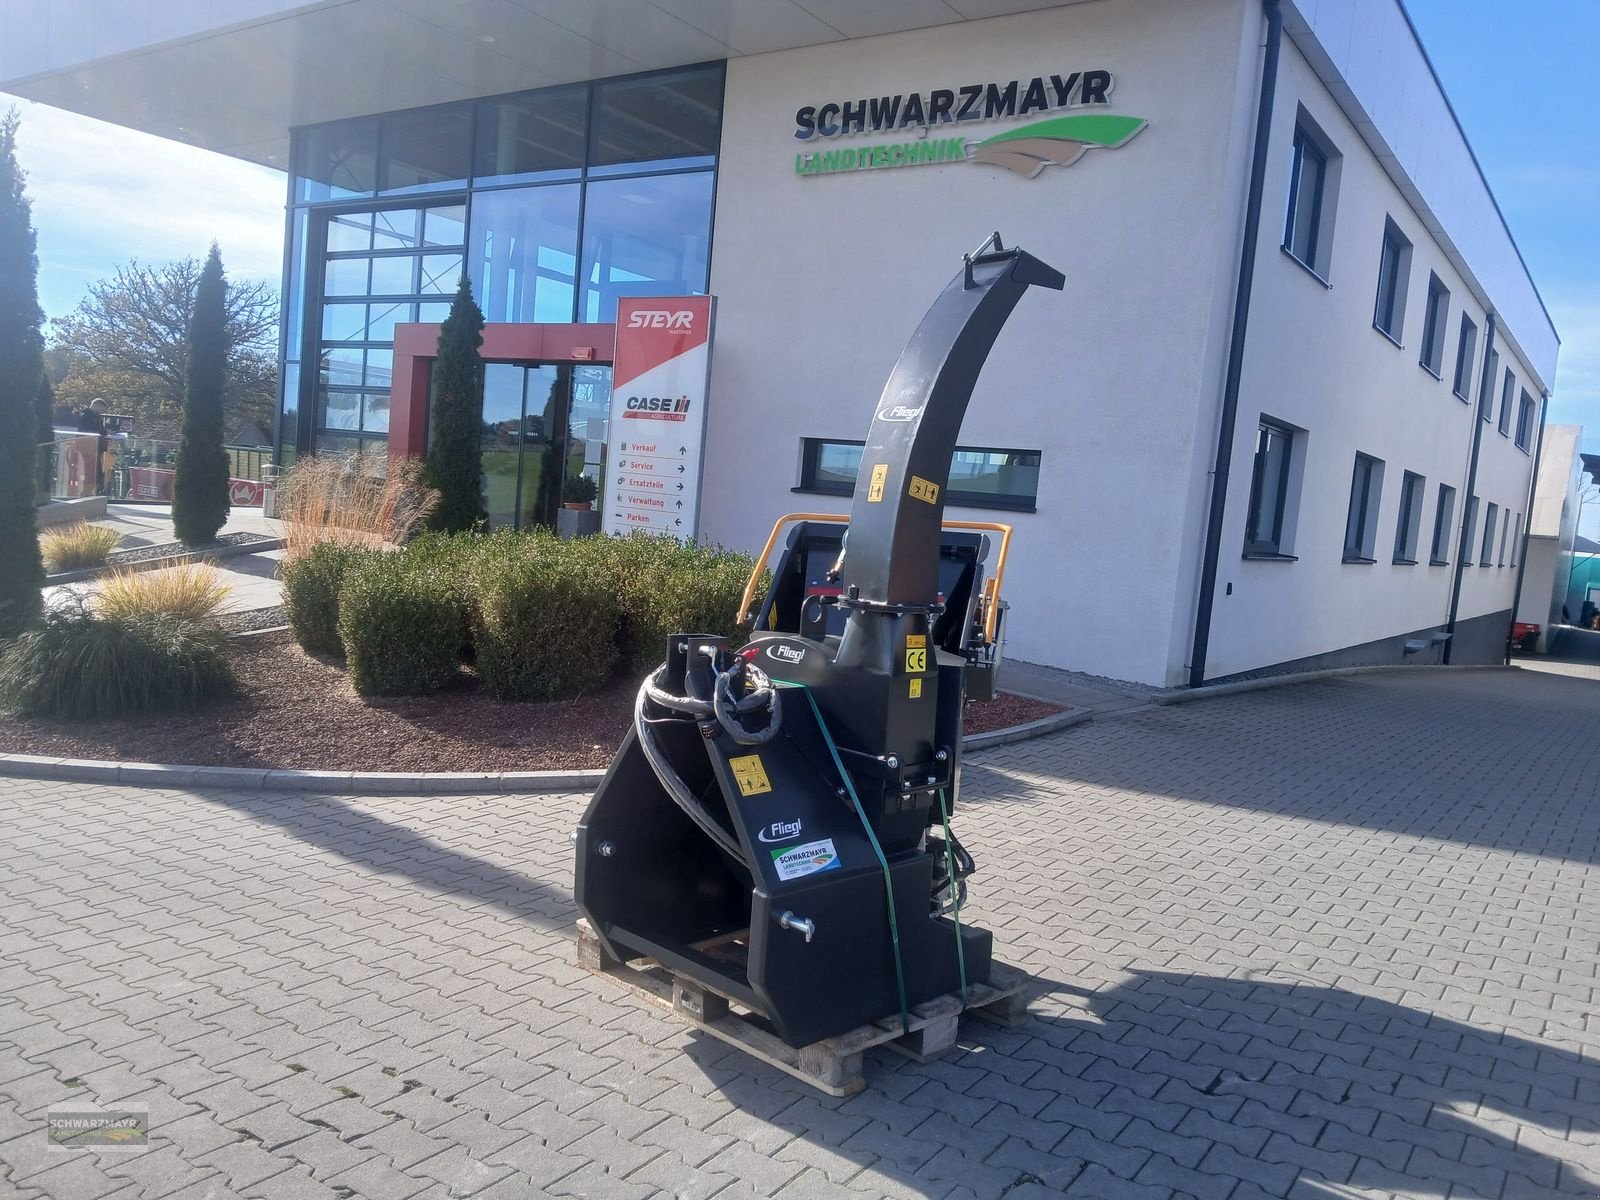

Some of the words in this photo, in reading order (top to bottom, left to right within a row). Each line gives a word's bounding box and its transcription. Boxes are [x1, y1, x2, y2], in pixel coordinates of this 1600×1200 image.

[794, 69, 1114, 141] SCHWARZMAYR
[795, 137, 967, 176] LANDTECHNIK
[627, 310, 694, 328] STEYR
[626, 396, 672, 412] CASE
[889, 405, 922, 420] Fliegl
[632, 443, 656, 453] Verkauf
[630, 461, 654, 471] Service
[629, 478, 664, 489] Ersatzteile
[628, 495, 665, 508] Verwaltung
[627, 513, 650, 523] Parken
[777, 645, 806, 664] Fliegl
[907, 651, 925, 670] CE
[771, 817, 802, 837] Fliegl
[779, 847, 828, 864] SCHWARZMAYR
